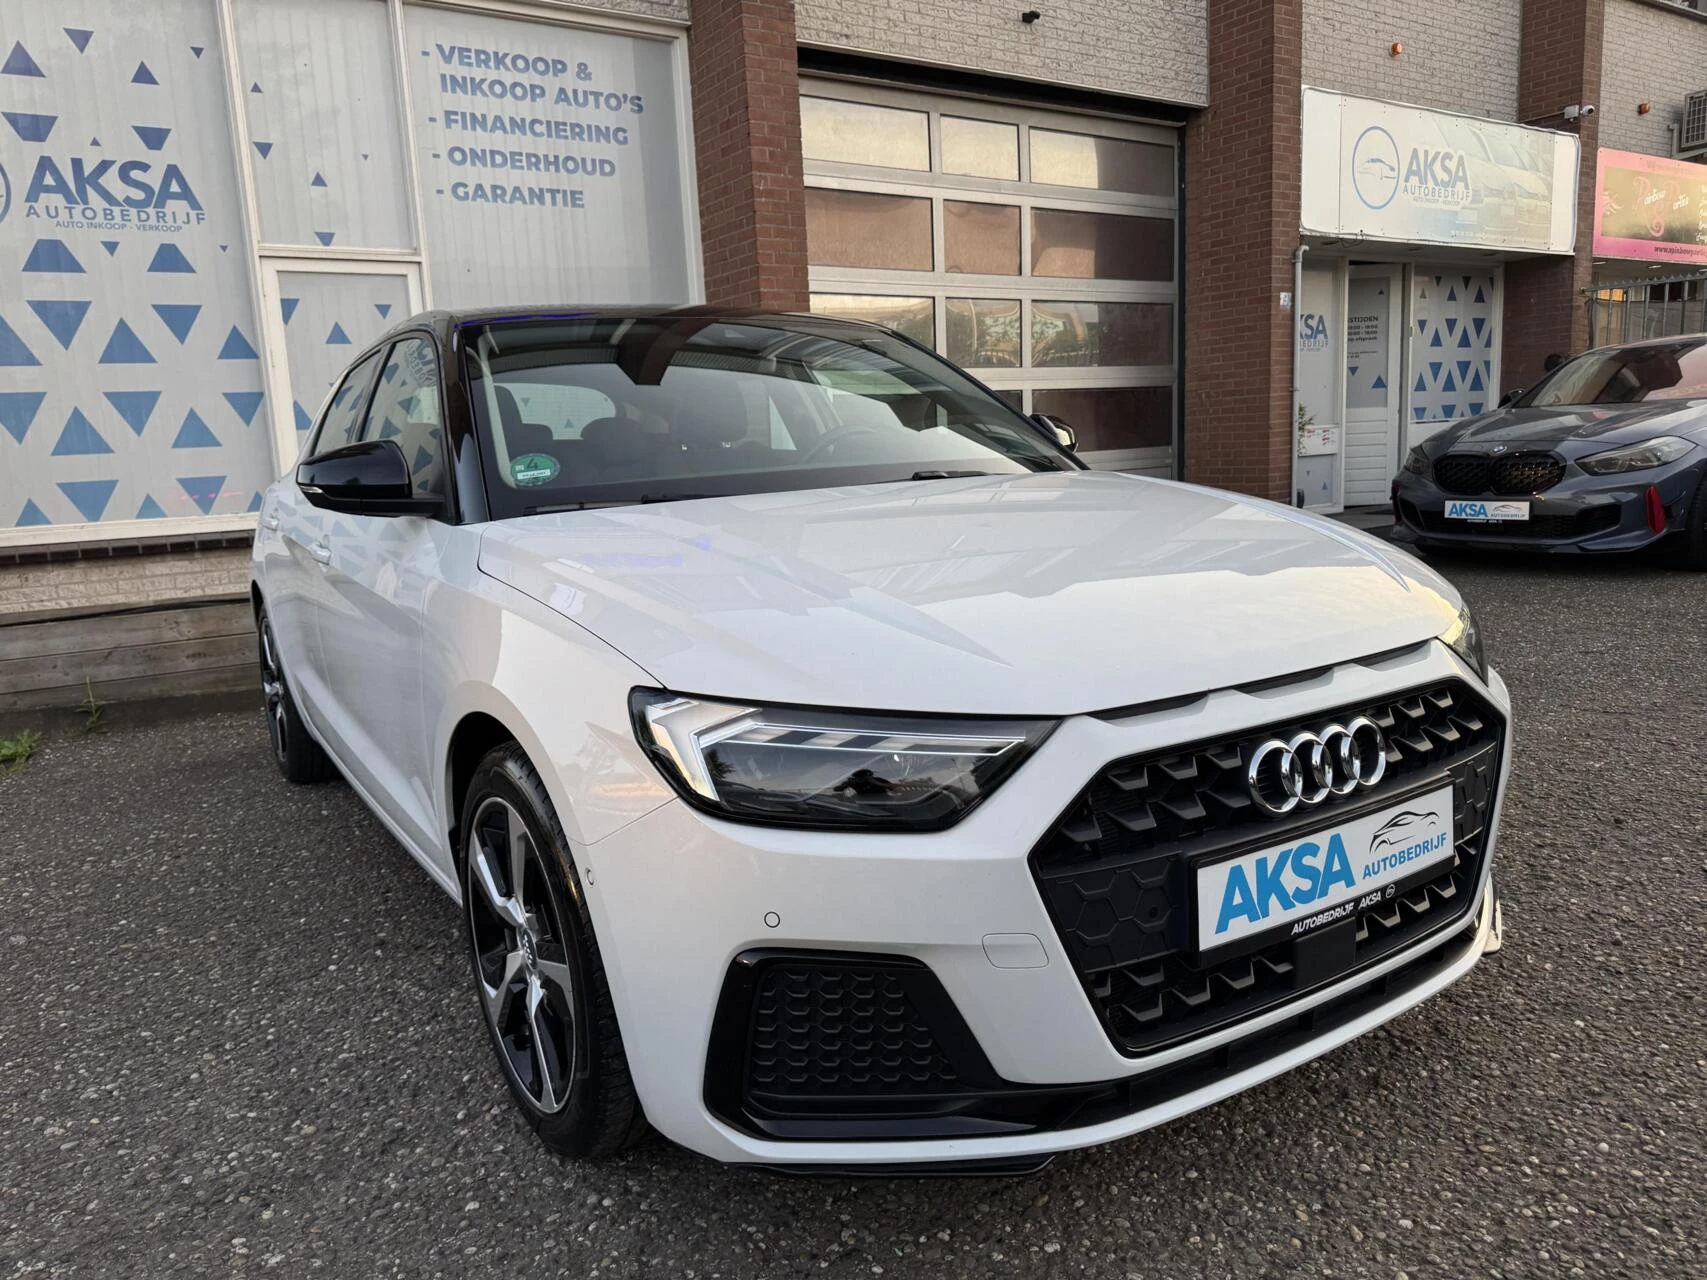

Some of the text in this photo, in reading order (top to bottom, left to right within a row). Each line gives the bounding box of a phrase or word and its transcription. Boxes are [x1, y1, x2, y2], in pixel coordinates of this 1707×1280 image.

[435, 43, 568, 78] VERKOOP
[575, 62, 593, 81] &
[440, 73, 644, 114] INKOOP AUTO'S
[443, 110, 629, 146] FINANCIERING
[447, 146, 616, 177] ONDERHOUD
[1404, 147, 1470, 191] AKSA
[24, 155, 204, 211] AKSA
[451, 182, 585, 208] GARANTIE
[1403, 184, 1470, 201] AUTOBEDRIJF
[25, 204, 206, 225] AUTOBEDRIJF
[55, 220, 84, 229] AUTO
[86, 221, 127, 231] INKOOP
[135, 224, 183, 232] VERKOOP
[1448, 503, 1488, 517] AKSA
[1362, 832, 1447, 880] AUTOBEDRIJF
[1215, 832, 1356, 935] AKSA
[1291, 891, 1382, 936] AUTOBEDRIJF AKSA
